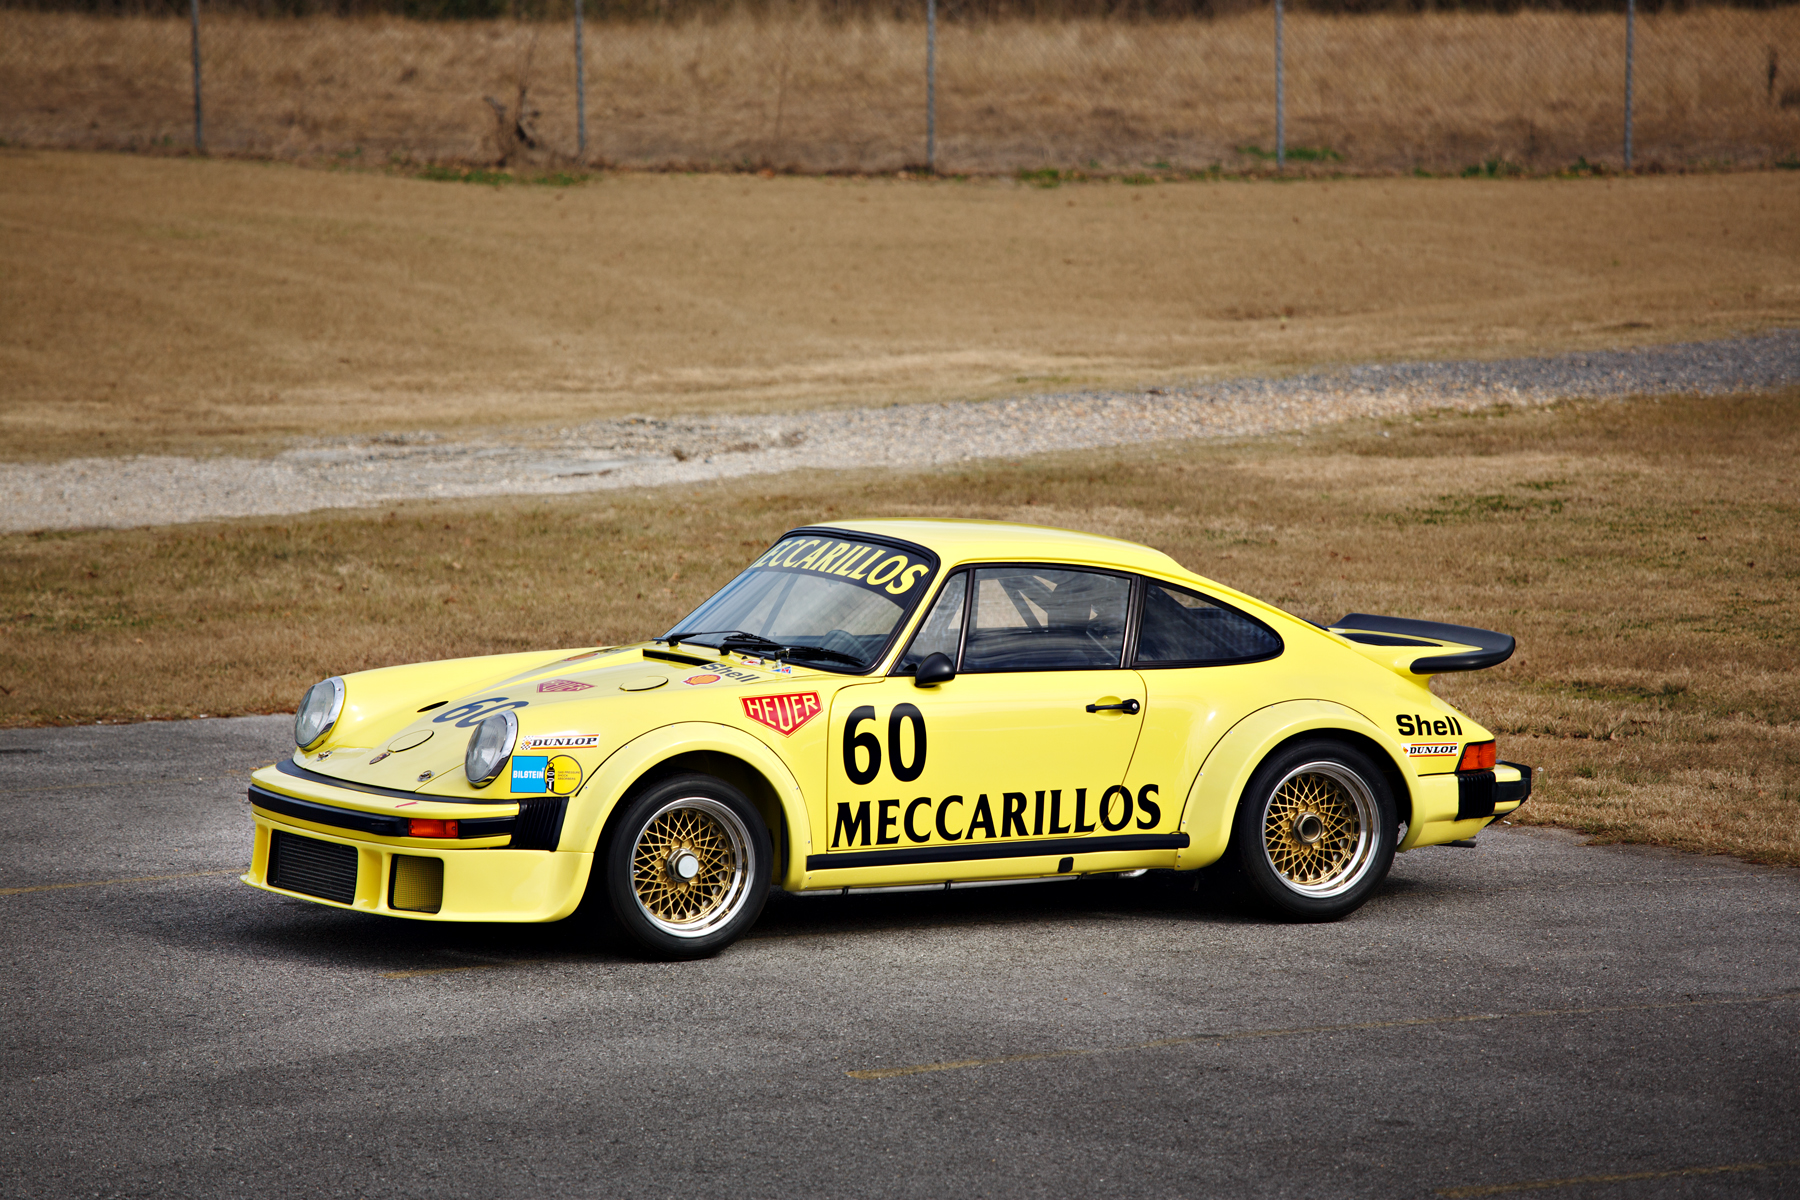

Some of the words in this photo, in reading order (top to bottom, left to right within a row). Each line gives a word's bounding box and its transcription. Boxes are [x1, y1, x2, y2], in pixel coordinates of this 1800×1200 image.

[700, 662, 761, 683] Shell
[746, 694, 819, 730] HEUER
[1396, 714, 1463, 736] Shell
[532, 736, 597, 747] DUNLOP
[842, 702, 928, 786] 60
[1409, 746, 1457, 754] DUNLOP
[513, 770, 544, 779] BILSTEIN
[831, 783, 1161, 848] MECCARILLOS
